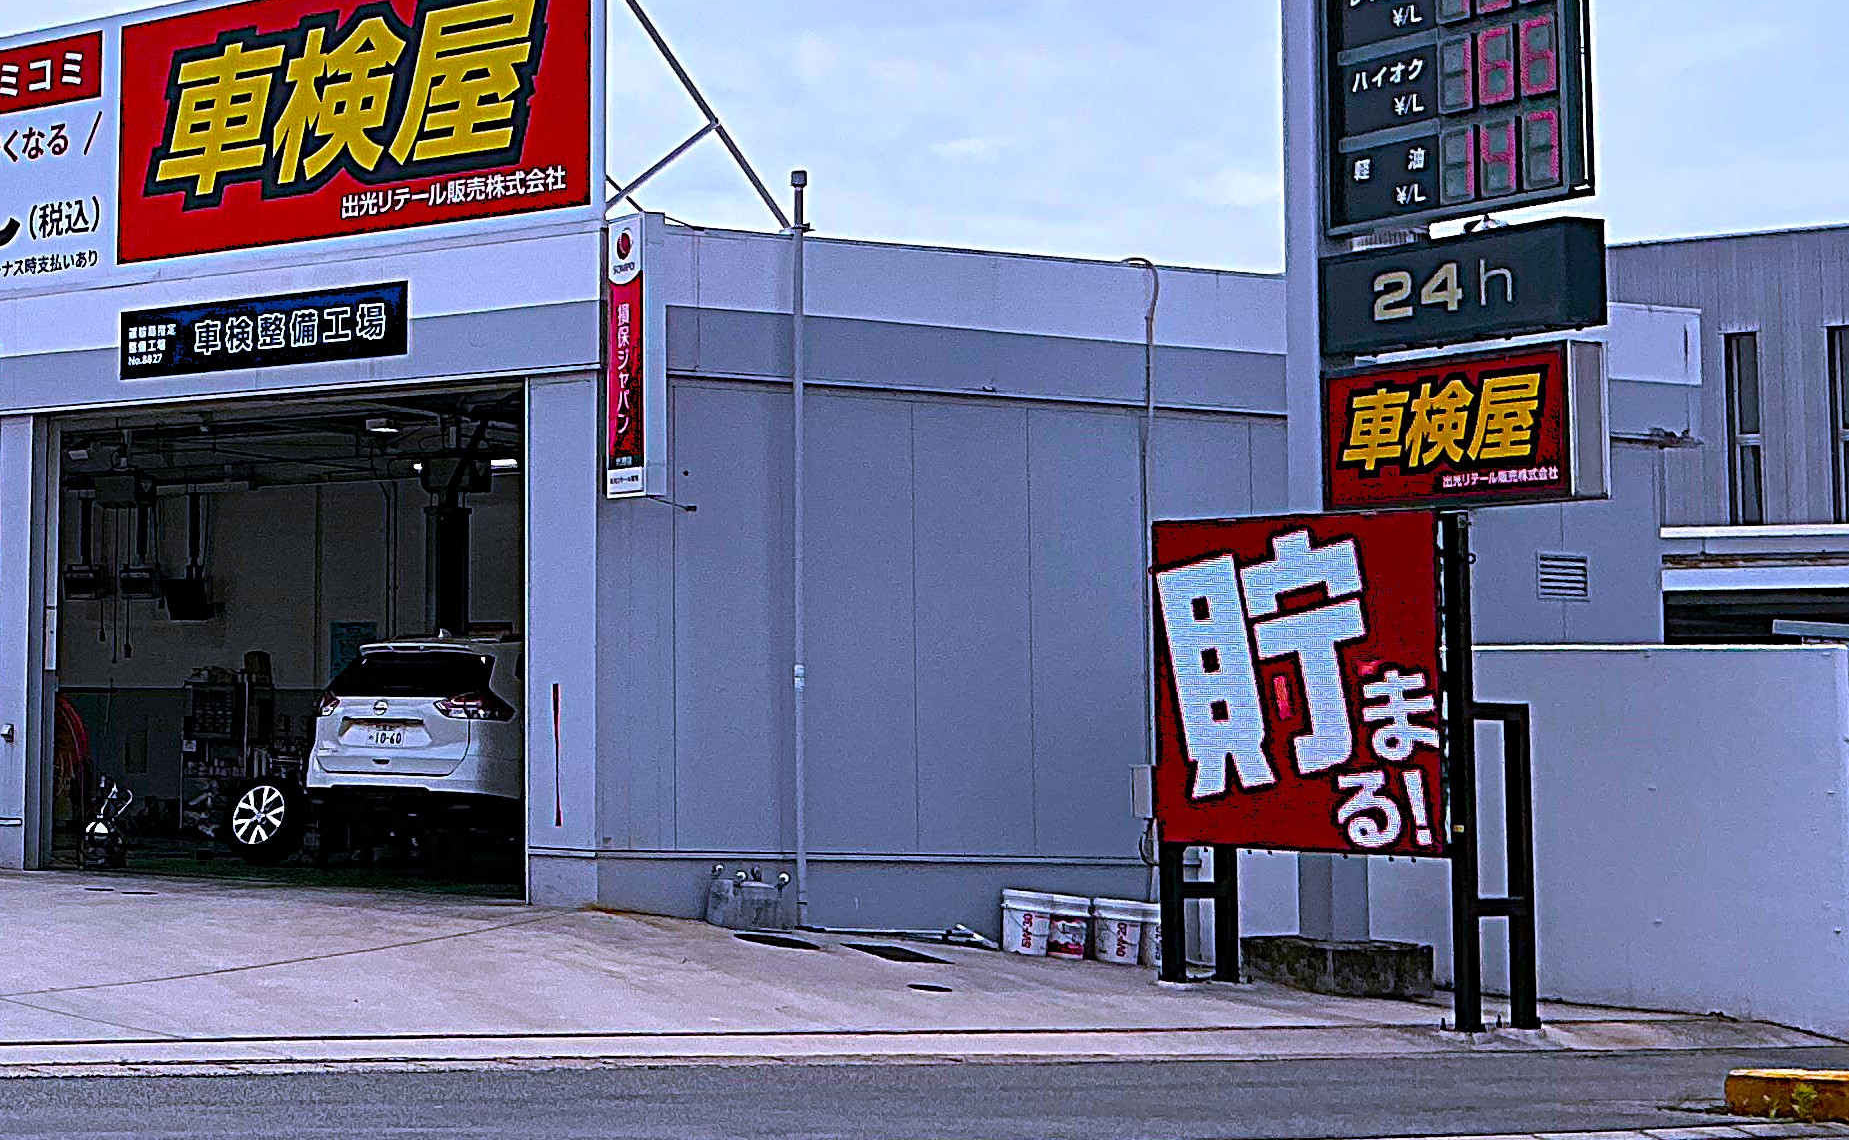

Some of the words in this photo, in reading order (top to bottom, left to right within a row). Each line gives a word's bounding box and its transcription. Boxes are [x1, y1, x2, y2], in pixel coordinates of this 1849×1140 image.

[1352, 58, 1424, 93] ハイオク
[1463, 16, 1557, 110] 166
[341, 166, 567, 219] 出光リテール販売株式会社
[194, 303, 387, 355] 車検整備工場
[616, 303, 630, 434] 損保ジャパン
[1342, 373, 1541, 470] 車検屋
